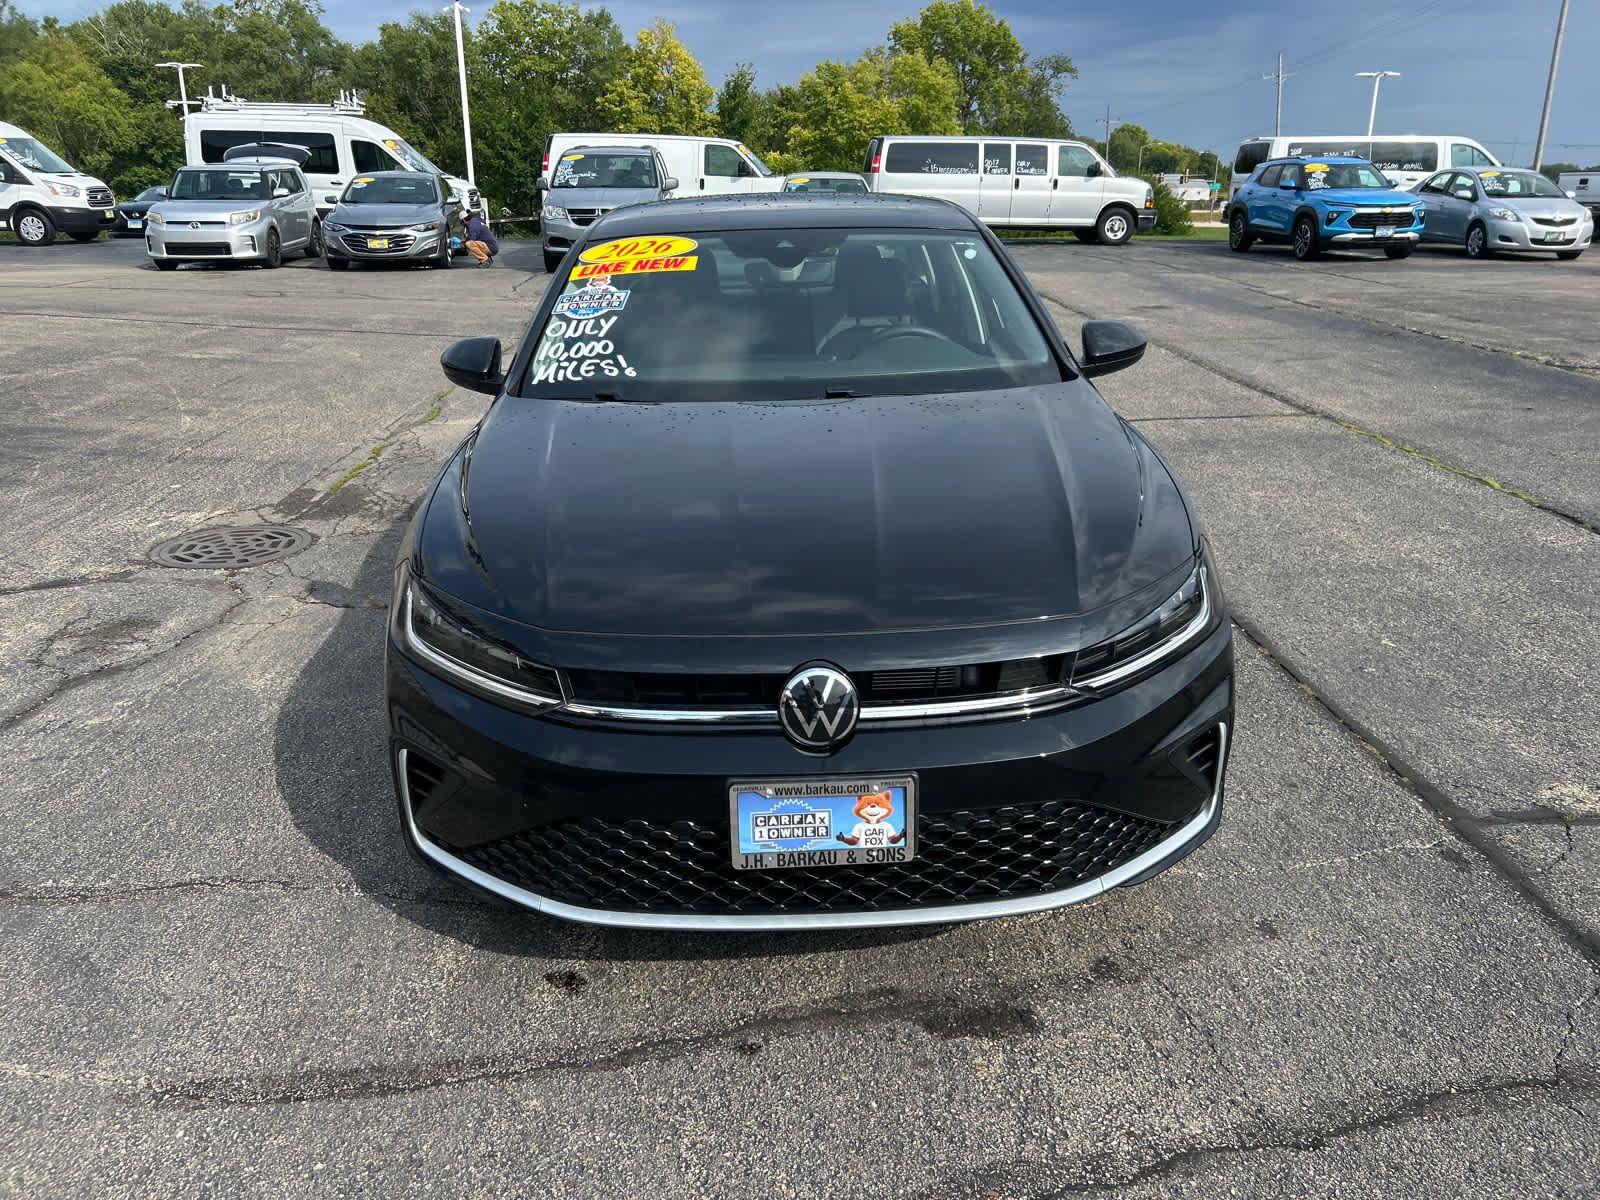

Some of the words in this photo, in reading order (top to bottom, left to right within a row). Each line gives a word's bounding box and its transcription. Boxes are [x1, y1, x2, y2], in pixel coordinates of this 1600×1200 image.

[984, 159, 1000, 168] 2017
[597, 239, 677, 260] 2026
[578, 261, 626, 277] LIKE
[632, 257, 688, 271] NEW
[562, 294, 624, 303] CARFAX
[568, 301, 621, 310] OWNER
[545, 316, 618, 338] ONLY
[539, 340, 614, 361] 10,000
[774, 783, 870, 796] www.barkau.com
[756, 814, 827, 826] CARFAX
[769, 827, 828, 839] OWNER
[864, 828, 885, 837] CAR
[864, 837, 884, 846] FOX
[741, 854, 767, 868] J.H.
[777, 851, 837, 867] BARKAU
[846, 849, 857, 863] &
[866, 848, 906, 862] SONS
